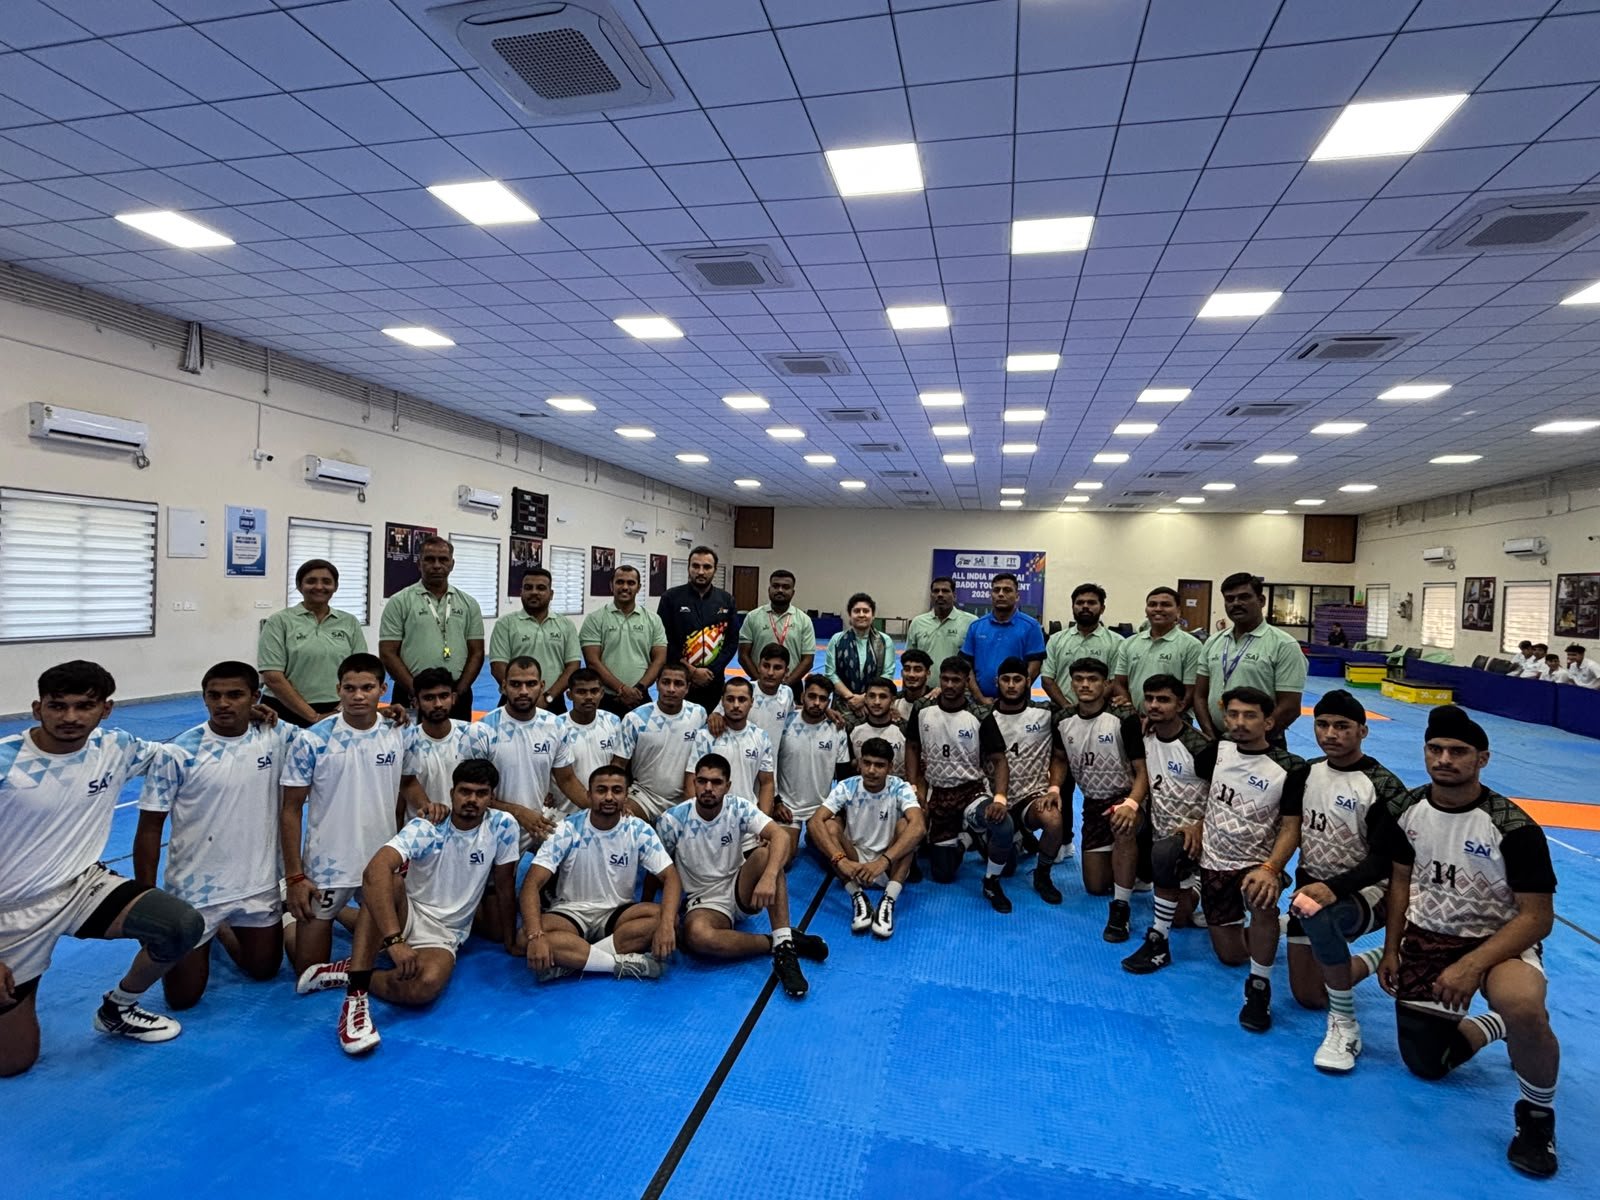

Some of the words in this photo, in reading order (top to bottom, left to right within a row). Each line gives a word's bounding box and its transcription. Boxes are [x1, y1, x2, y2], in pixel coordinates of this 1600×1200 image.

[966, 572, 987, 580] INDIA
[942, 744, 950, 758] 8
[1009, 742, 1019, 757] 4
[1153, 774, 1163, 791] 2
[1217, 784, 1235, 806] 11
[1309, 809, 1327, 832] 13
[1432, 860, 1456, 888] 14
[321, 890, 335, 908] 5
